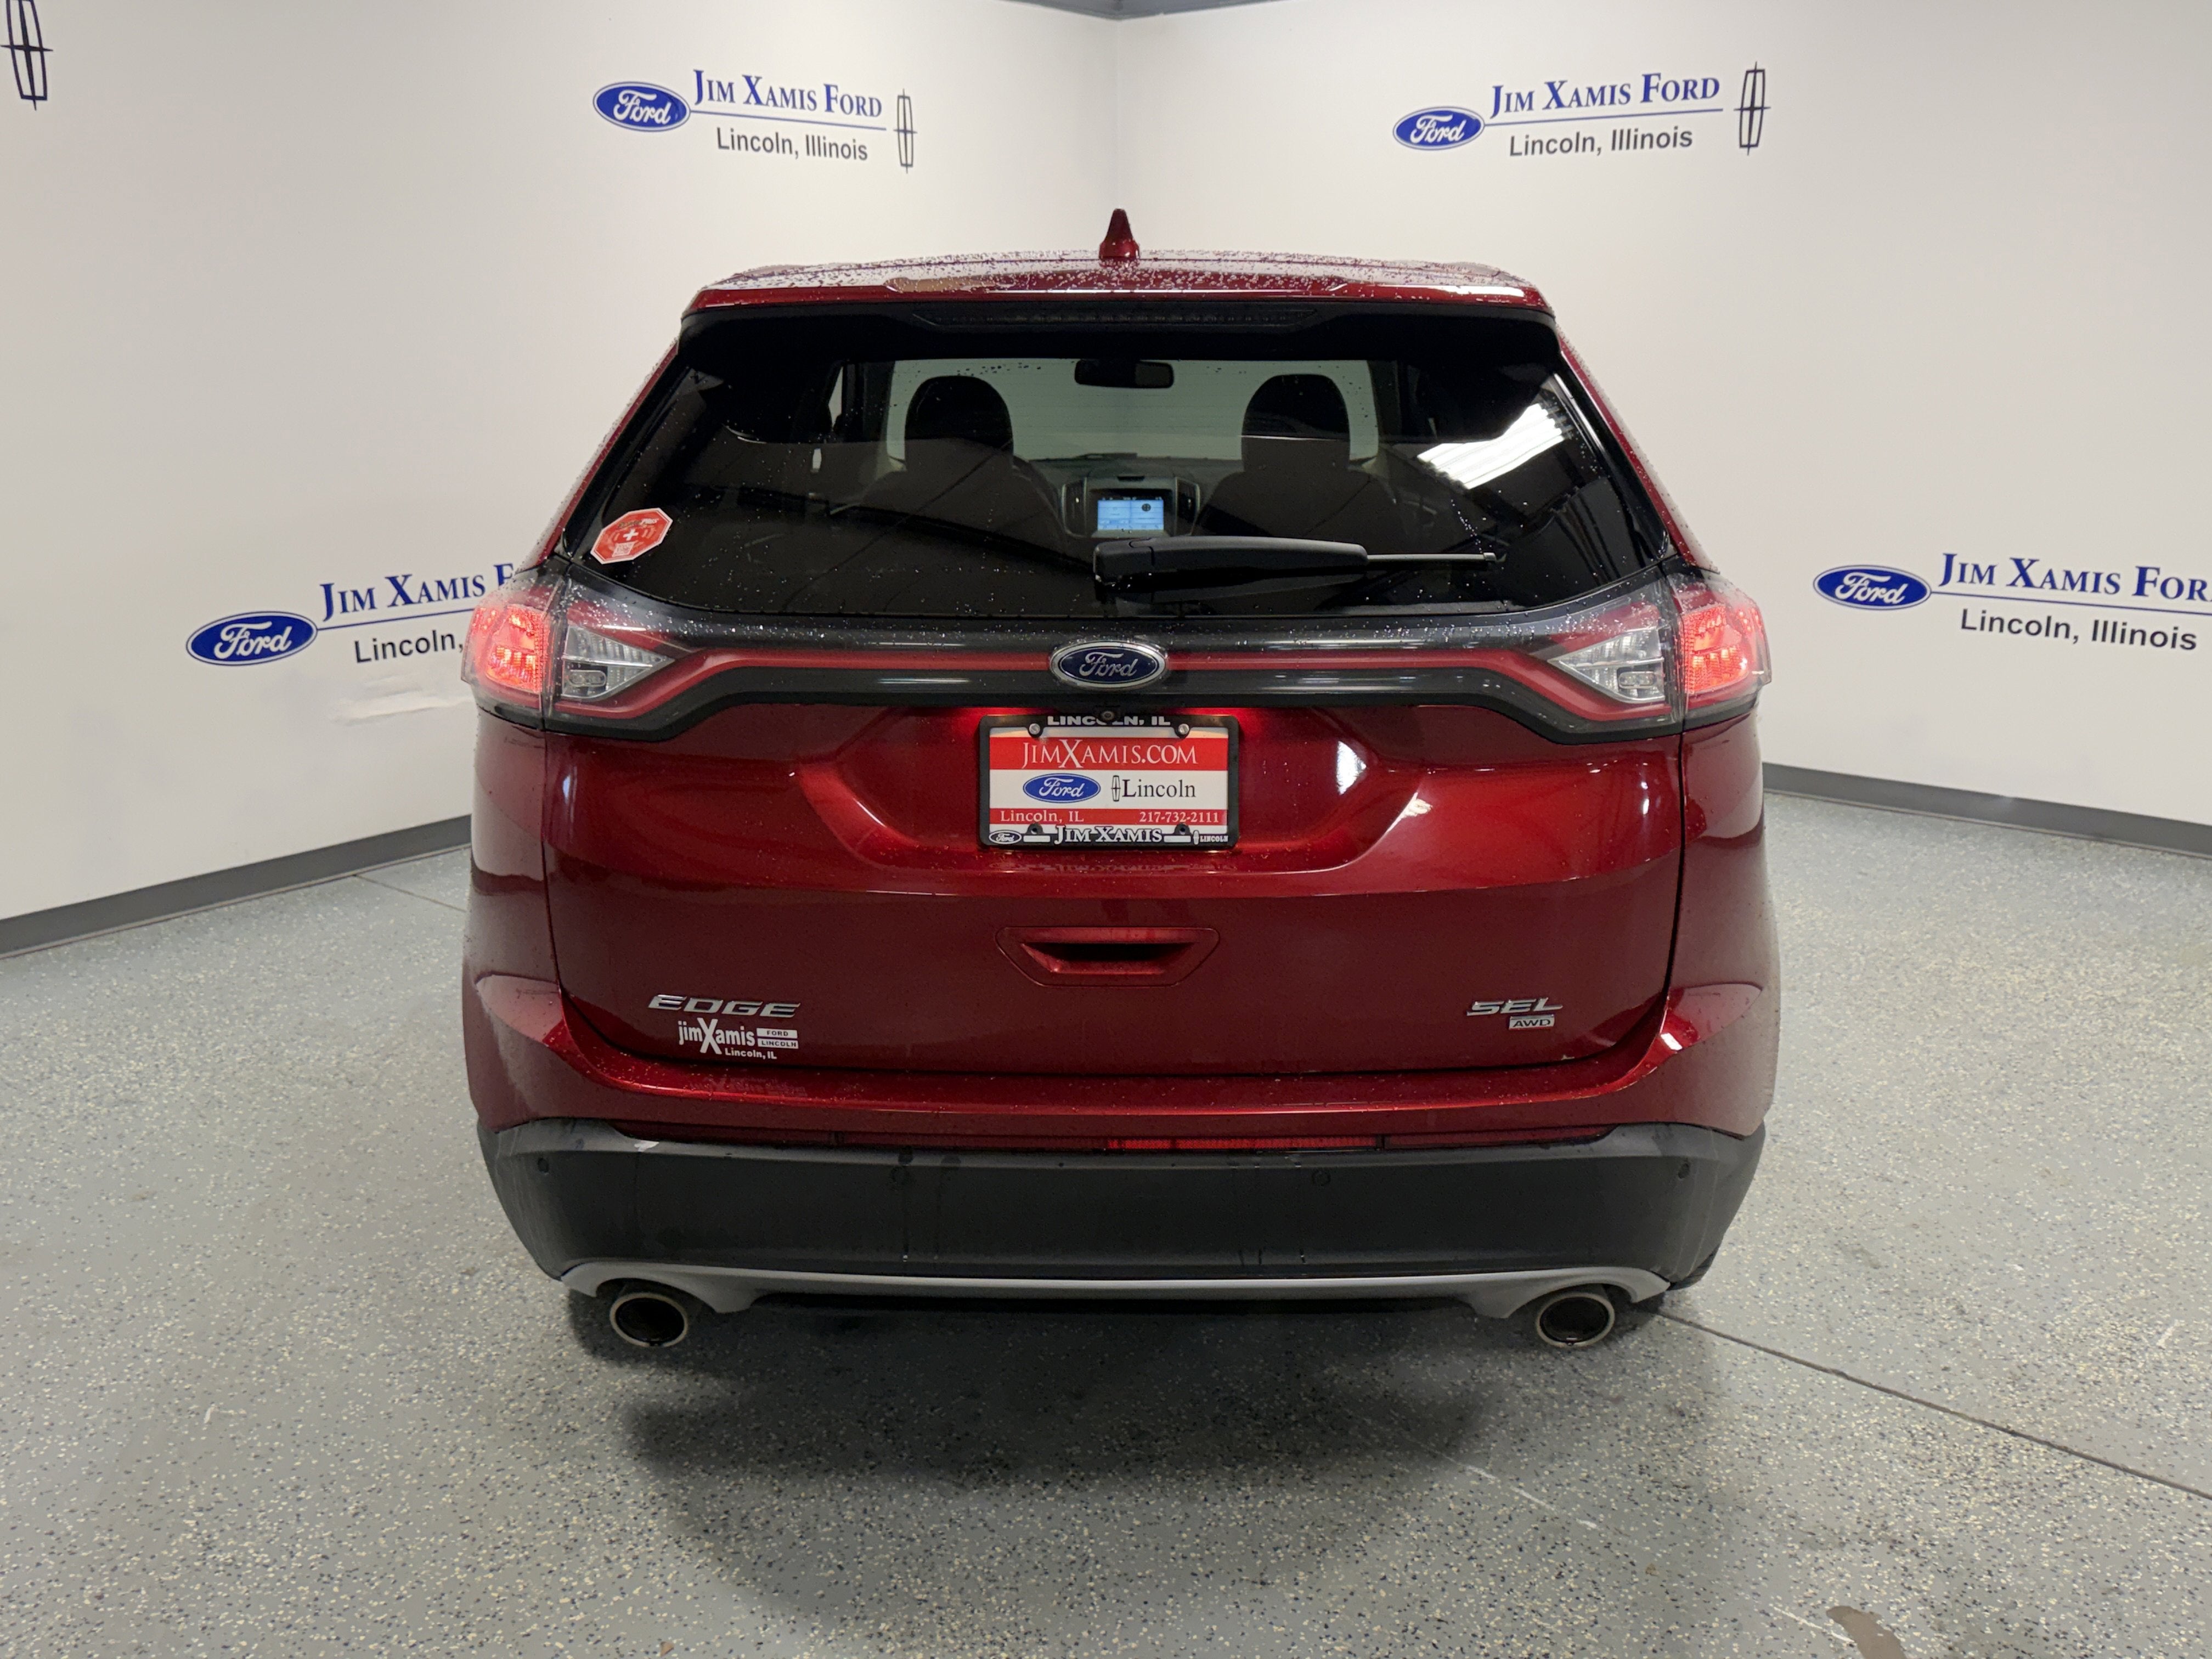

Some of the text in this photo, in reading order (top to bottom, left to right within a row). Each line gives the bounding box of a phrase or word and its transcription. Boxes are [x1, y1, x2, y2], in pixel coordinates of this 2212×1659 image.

[613, 89, 671, 125] Ford
[693, 69, 882, 117] JIM XAMIS FORD
[1491, 73, 1720, 118] JIM XAMIS FORD
[1410, 114, 1465, 143] Ford
[1510, 126, 1693, 156] Lincoln, Illinois
[717, 127, 868, 160] Lincoln, Illinois
[1835, 573, 1907, 605] Ford
[1938, 553, 2212, 601] JIM XAMIS FOR
[320, 583, 377, 622] JIM
[385, 574, 486, 608] XAMIS
[214, 621, 292, 659] Ford
[1961, 609, 2197, 651] Lincoln, Illinois
[354, 630, 463, 663] Lincoln,
[1080, 652, 1138, 676] Ford
[1152, 716, 1171, 725] IL
[1022, 739, 1197, 769] JIMXAMIS.COM
[1039, 777, 1084, 798] Ford
[1122, 779, 1196, 797] Lincoln
[1000, 811, 1084, 823] Lincoln, IL
[1139, 811, 1218, 822] 217-732-2111
[996, 833, 1015, 842] Ford
[1054, 826, 1163, 844] JIM XAMIS
[648, 994, 801, 1018] EDGE
[1466, 997, 1563, 1016] SEL
[725, 1048, 777, 1059] Lincoln, IL
